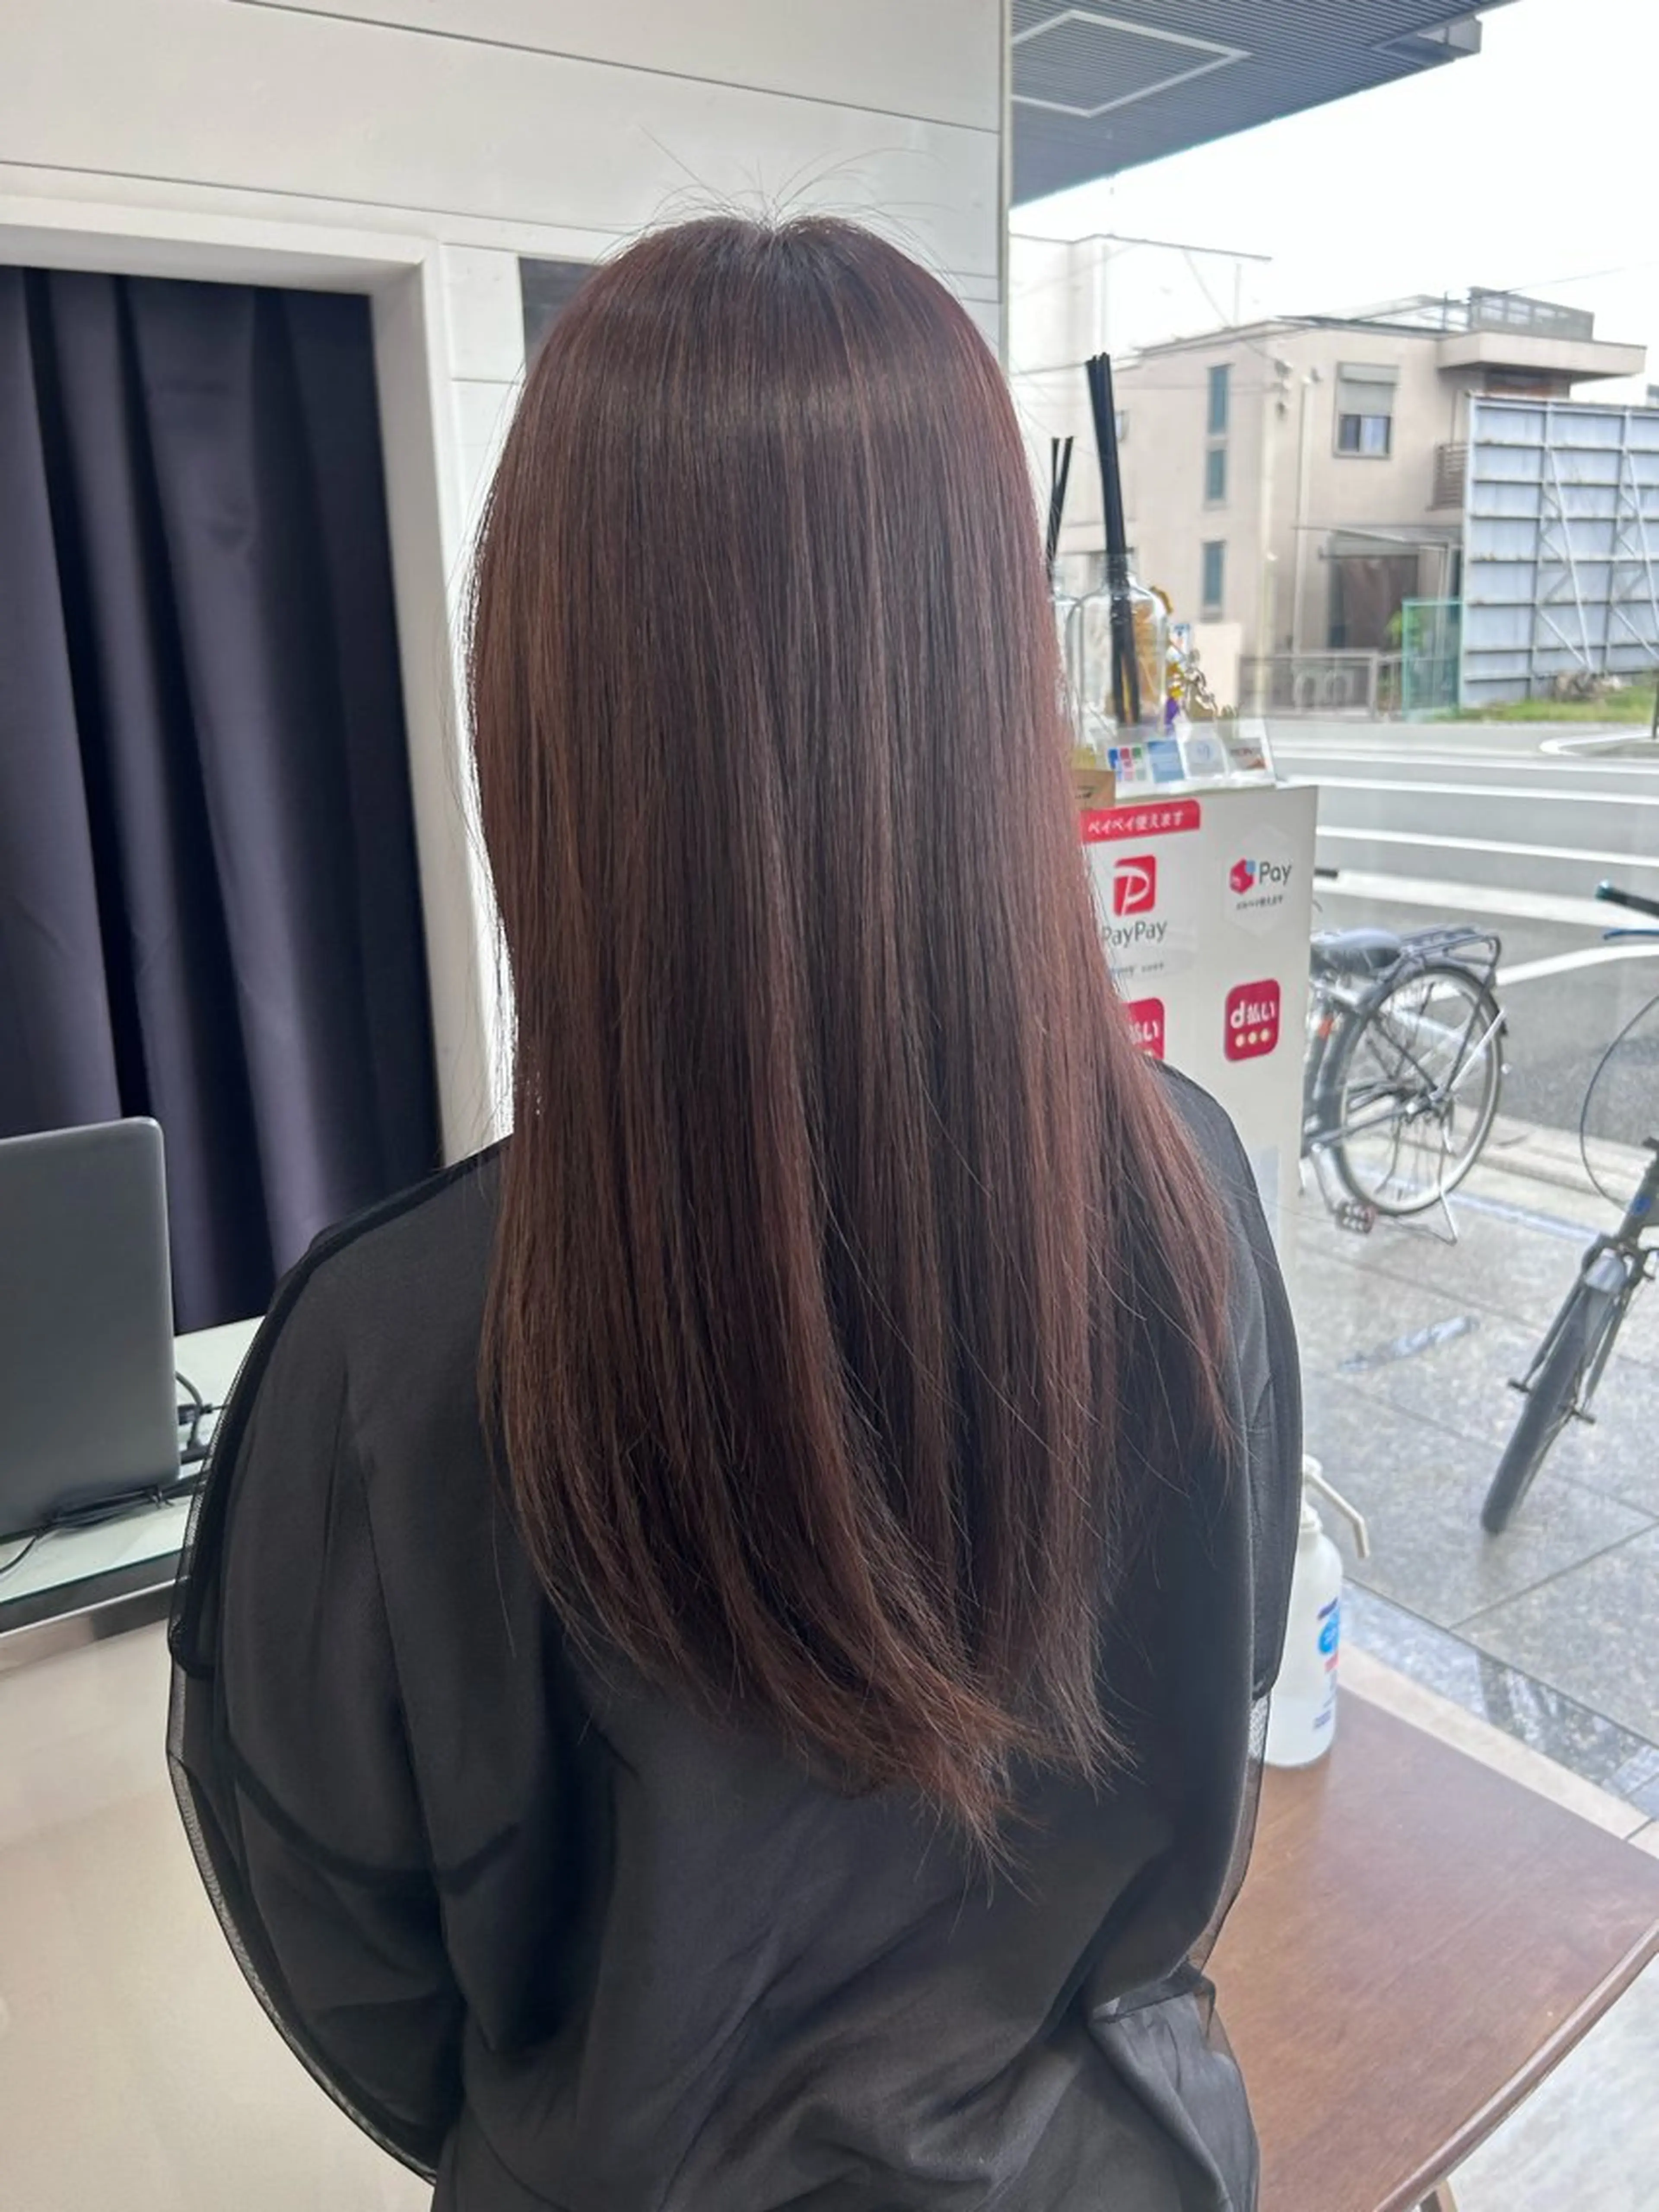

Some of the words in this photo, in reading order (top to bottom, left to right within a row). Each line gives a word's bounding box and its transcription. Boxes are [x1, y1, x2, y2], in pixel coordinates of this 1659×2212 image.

[1259, 861, 1292, 886] Pay
[1102, 920, 1167, 948] PayPay
[1230, 1000, 1275, 1029] d払い
